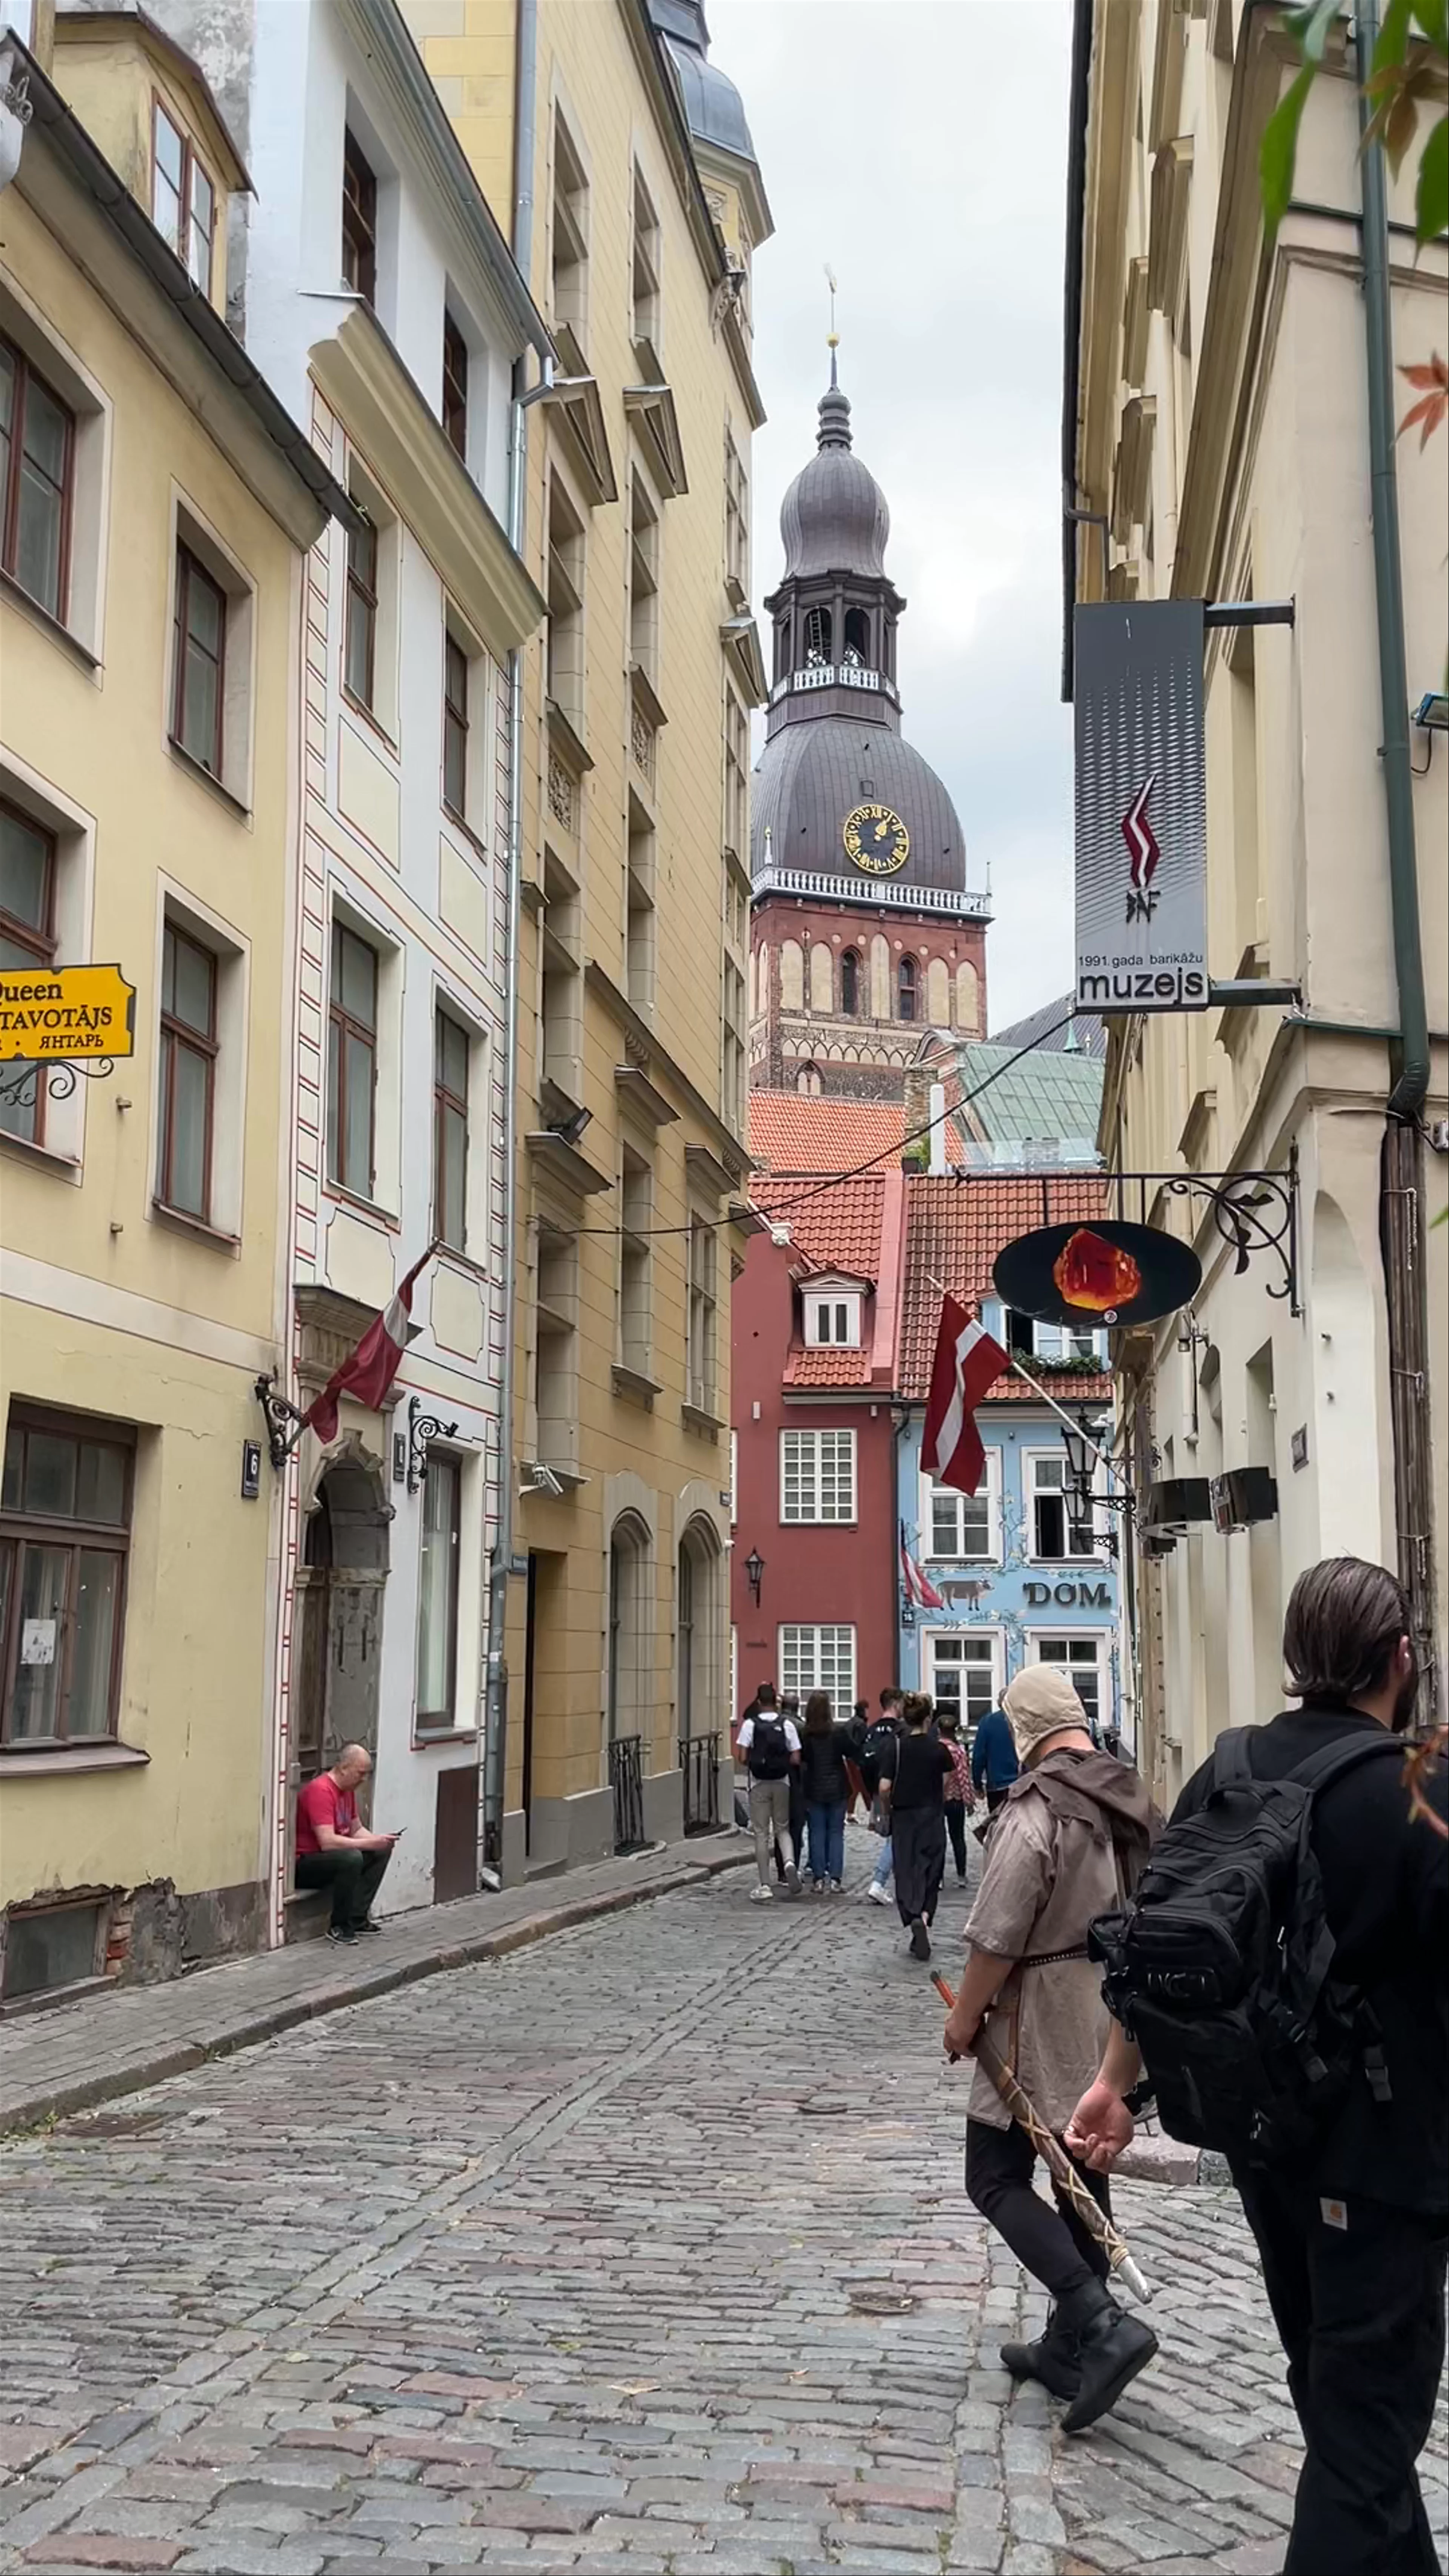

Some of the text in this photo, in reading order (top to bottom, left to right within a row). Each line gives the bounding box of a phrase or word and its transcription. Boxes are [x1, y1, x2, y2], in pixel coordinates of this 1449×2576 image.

[1112, 955, 1143, 968] gada
[0, 982, 63, 1002] ueen
[1080, 967, 1203, 1005] muzejs
[39, 1034, 104, 1049] ЯНТАРЬ
[251, 1453, 258, 1475] 6
[1023, 1582, 1111, 1607] DOM
